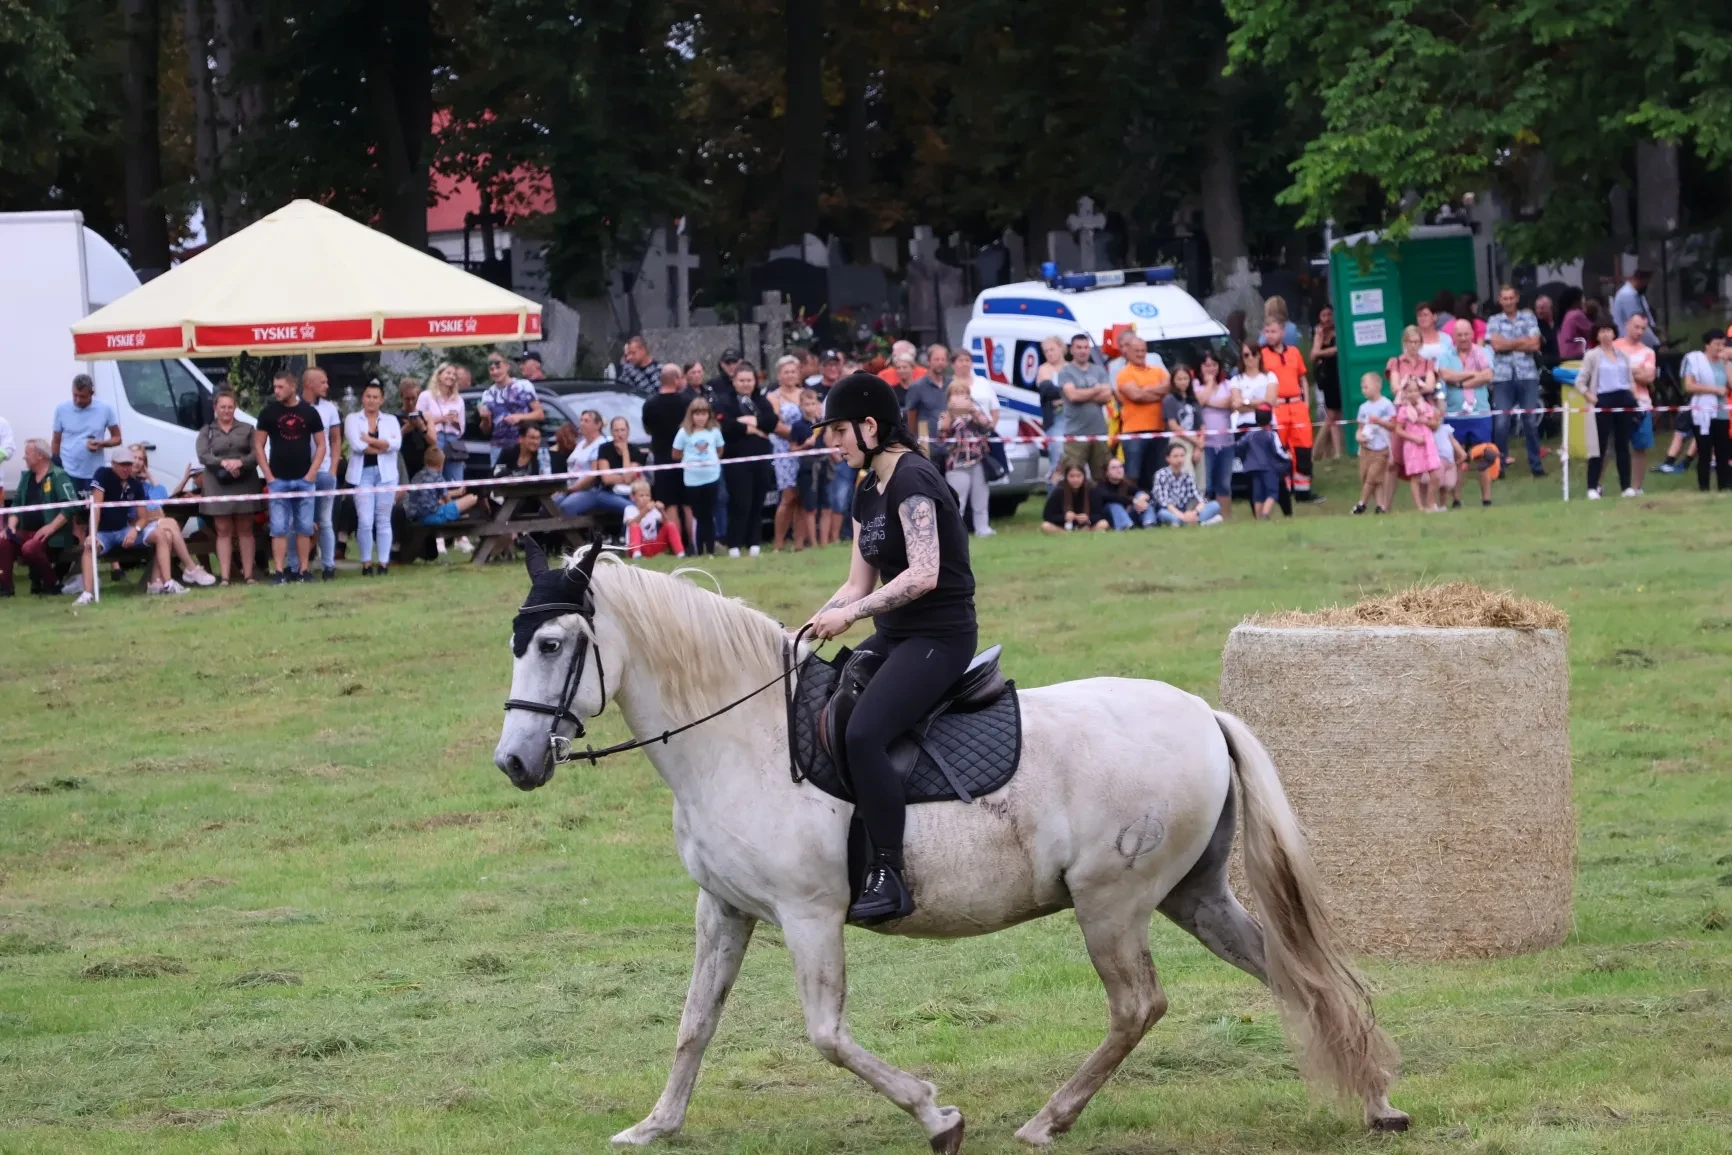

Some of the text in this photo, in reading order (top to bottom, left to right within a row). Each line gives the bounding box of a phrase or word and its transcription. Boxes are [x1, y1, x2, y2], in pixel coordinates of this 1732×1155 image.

[428, 320, 464, 333] TYSKIE
[252, 327, 298, 340] TYSKIE
[106, 334, 134, 347] TYSKIE
